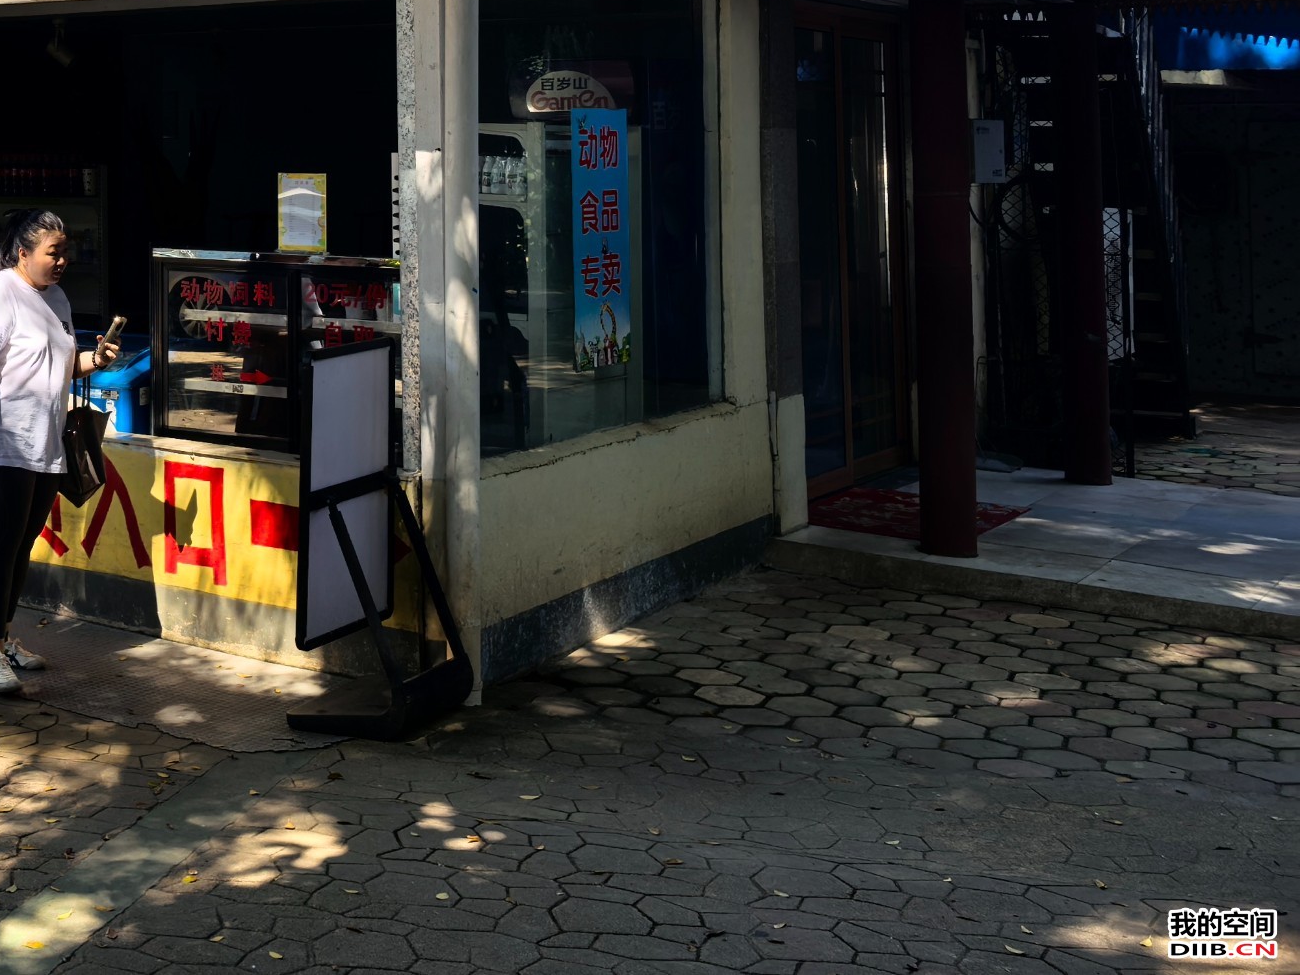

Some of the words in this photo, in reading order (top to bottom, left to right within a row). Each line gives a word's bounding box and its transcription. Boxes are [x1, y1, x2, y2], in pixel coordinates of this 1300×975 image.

[540, 77, 589, 91] 百岁山
[579, 126, 619, 170] 动物
[579, 188, 622, 237] 食品
[180, 277, 275, 307] 动物饲料
[580, 255, 623, 298] 专卖
[205, 317, 253, 346] 付费
